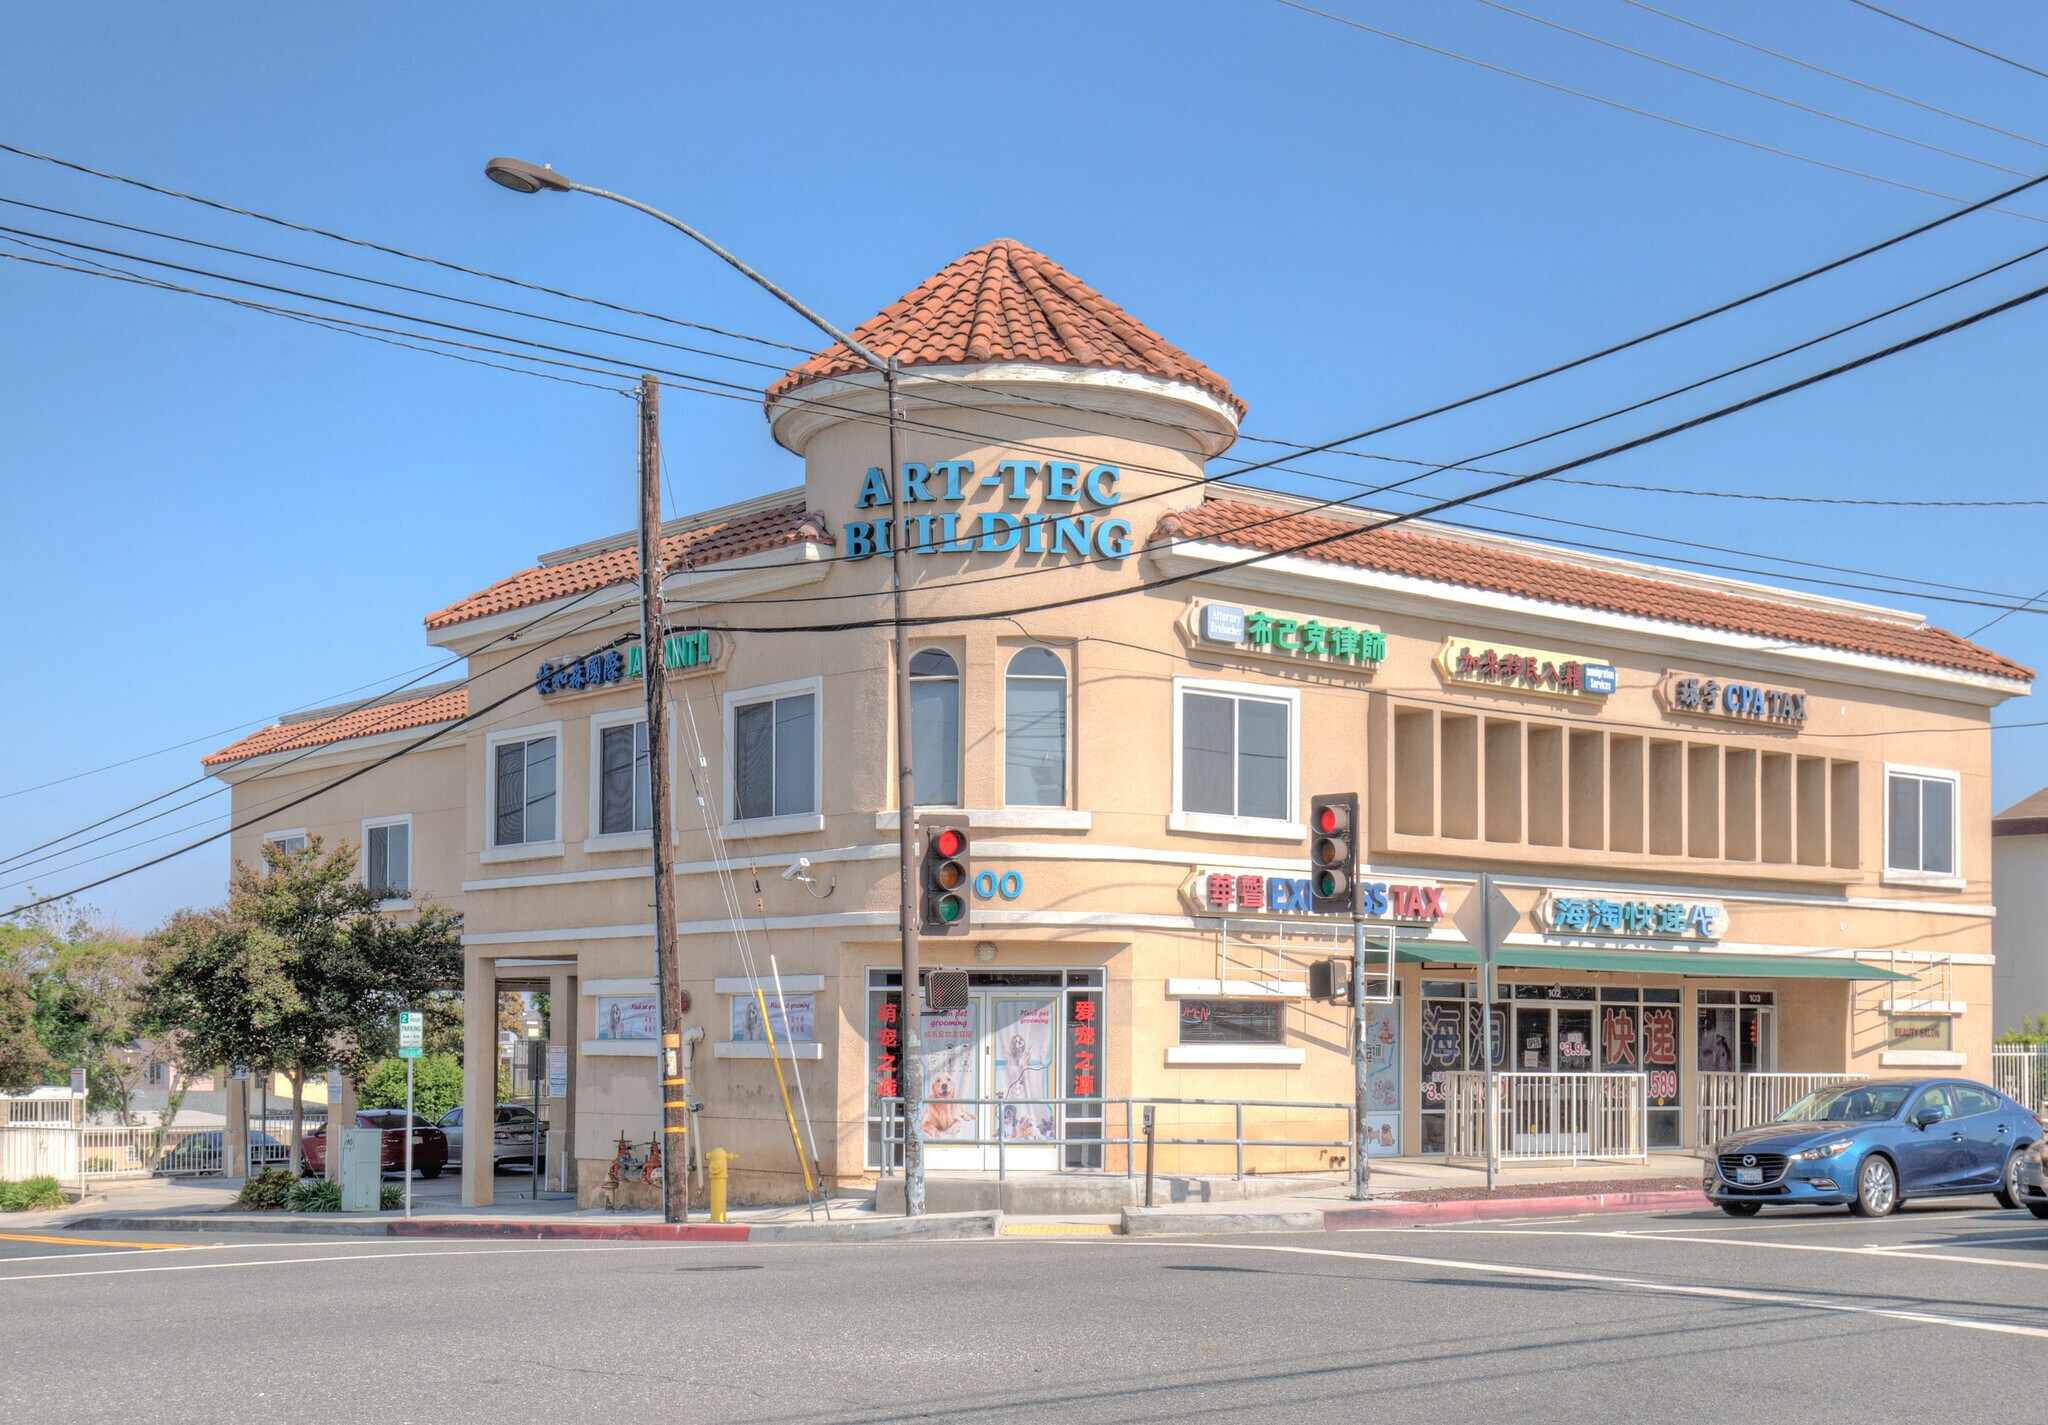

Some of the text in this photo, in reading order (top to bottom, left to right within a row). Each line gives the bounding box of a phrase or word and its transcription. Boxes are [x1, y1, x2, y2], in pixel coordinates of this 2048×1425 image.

[854, 460, 1121, 508] ART-TEC
[843, 512, 1132, 561] BUILDING
[1211, 609, 1242, 625] Attorney
[1210, 621, 1242, 636] Brubacher
[1590, 678, 1612, 691] Services
[1723, 683, 1765, 715] CPA
[1766, 690, 1808, 720] TAX
[1390, 885, 1444, 918] TAX
[1553, 897, 1689, 933] 海淘快递
[1548, 989, 1561, 998] 102
[1749, 994, 1761, 1003] 103
[402, 1014, 408, 1023] 2
[955, 1009, 967, 1018] pet
[930, 1019, 967, 1028] grooming
[1423, 1006, 1506, 1066] 海淘
[1602, 1008, 1676, 1064] 快递
[1894, 1027, 1940, 1038] BEAUTY SALON
[1074, 1001, 1096, 1095] 爱宠之源
